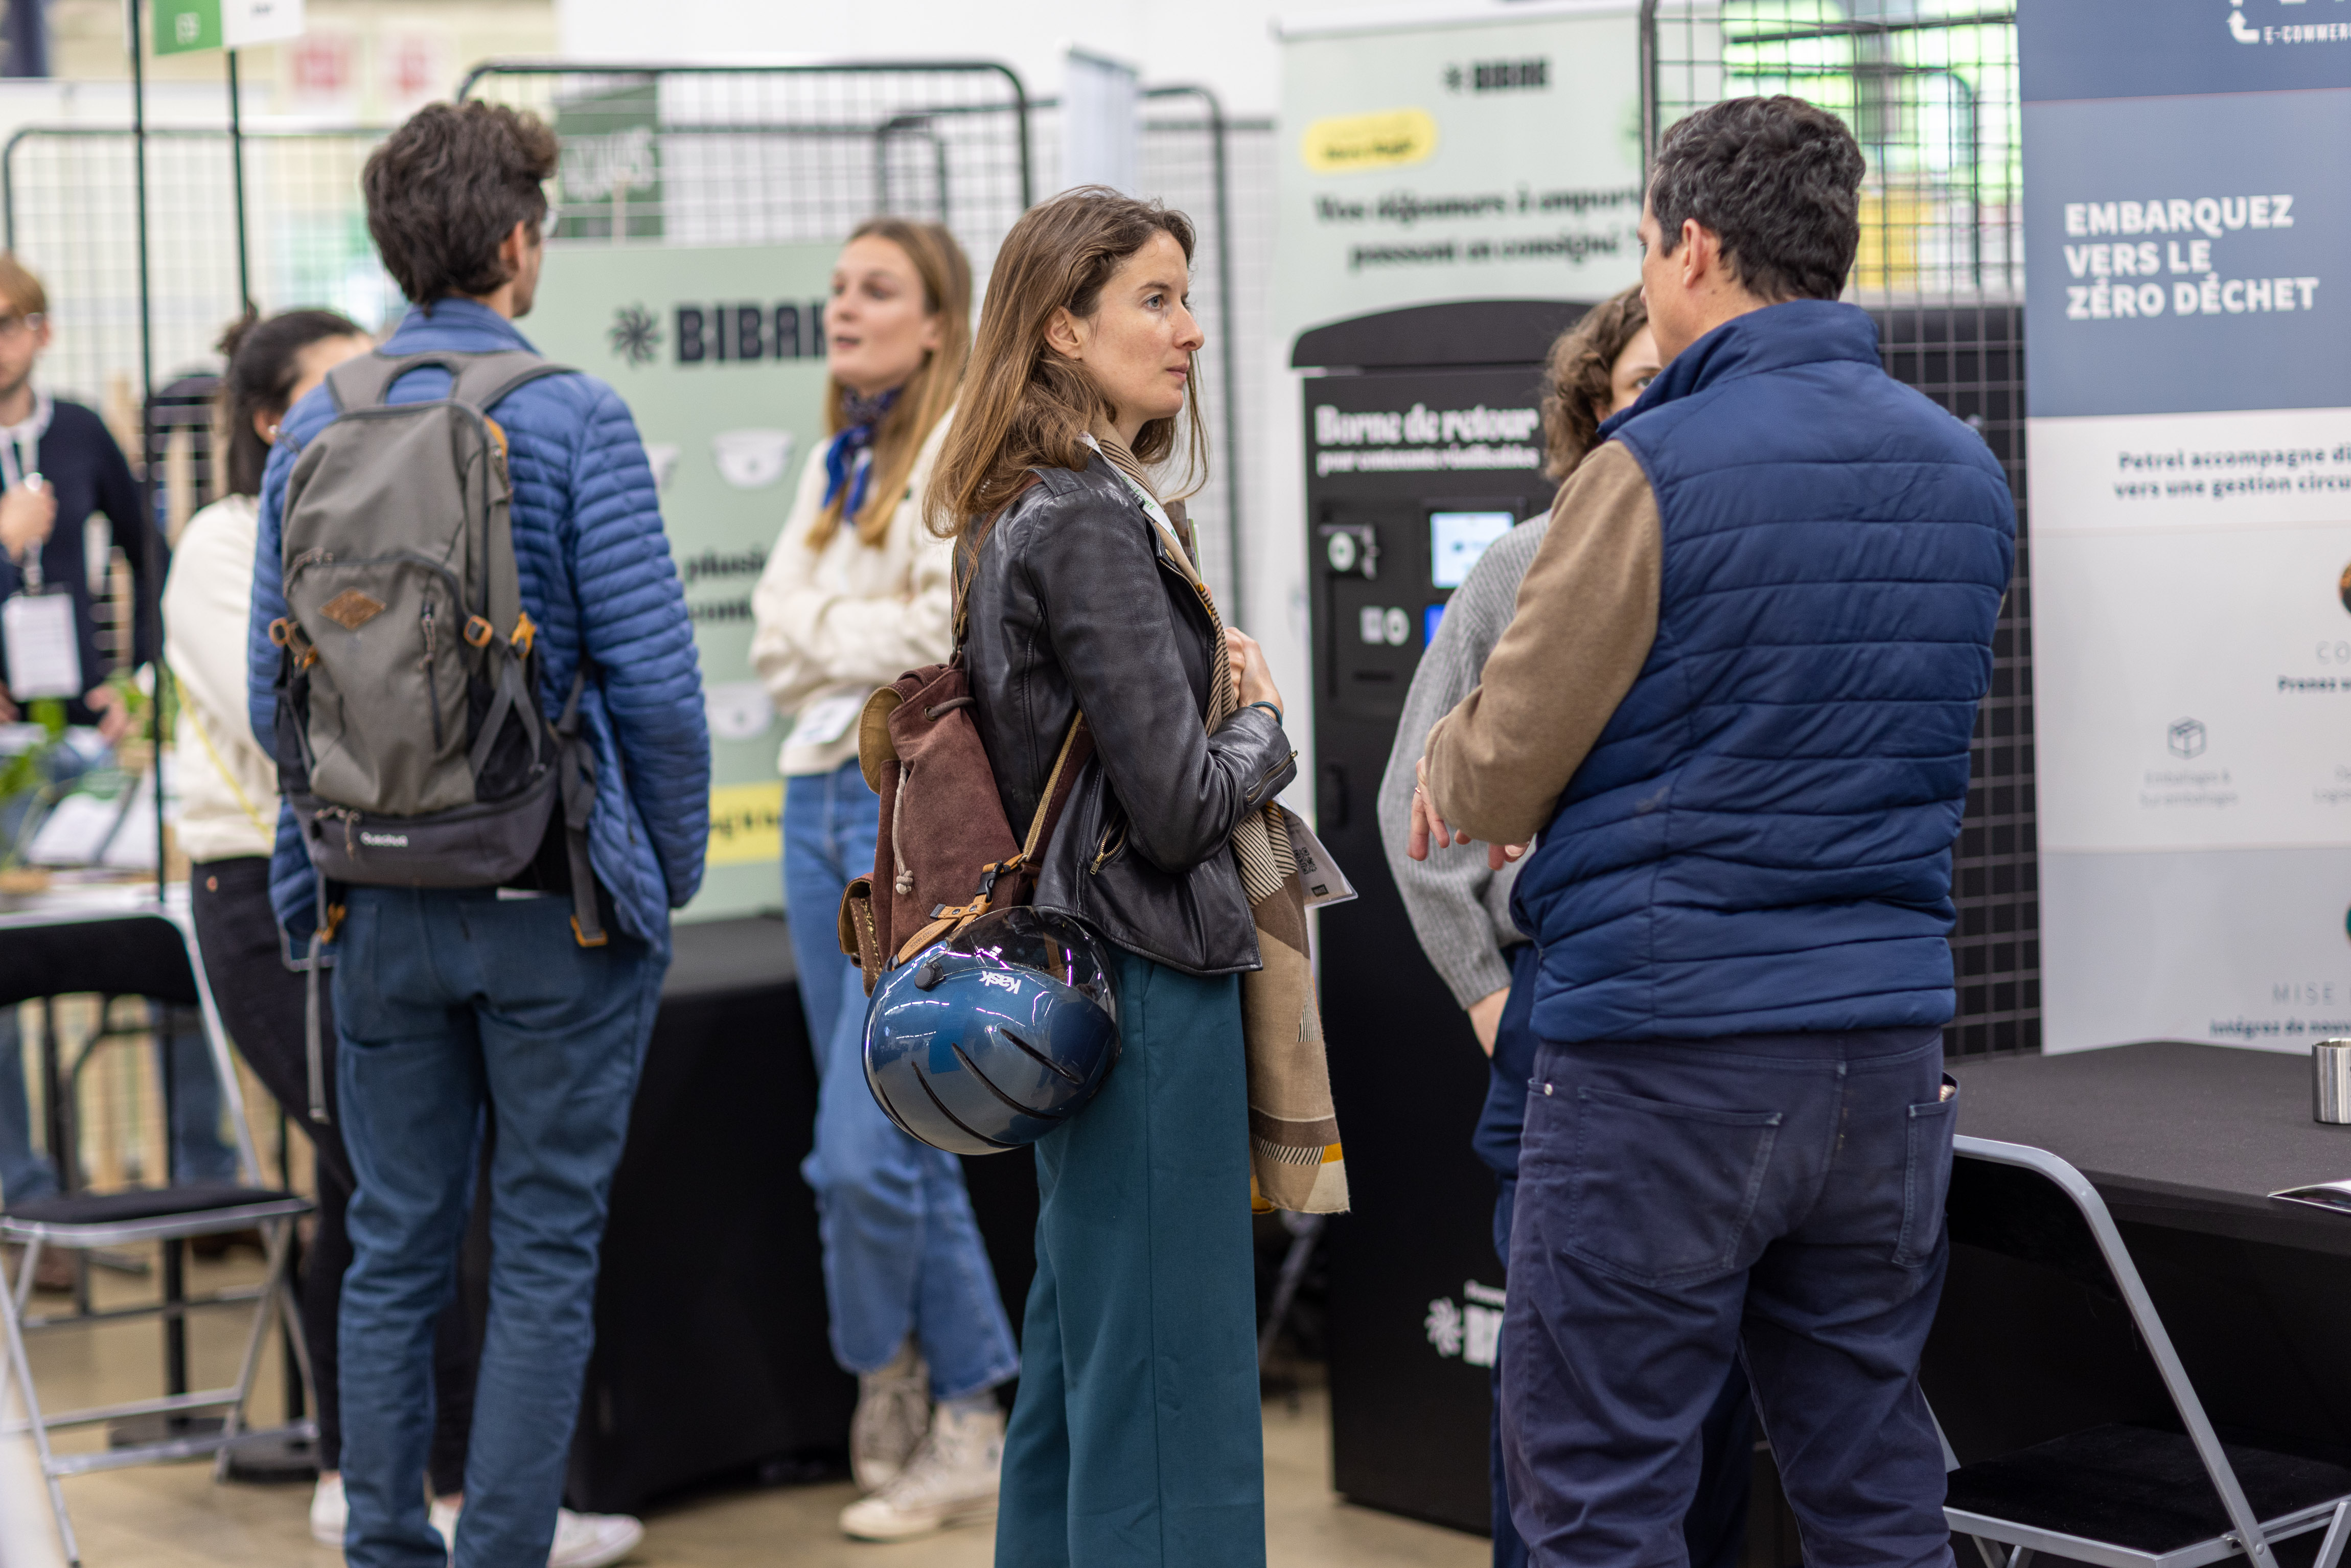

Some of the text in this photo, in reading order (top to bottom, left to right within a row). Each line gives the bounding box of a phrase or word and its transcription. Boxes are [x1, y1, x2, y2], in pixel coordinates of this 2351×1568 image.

[2065, 195, 2294, 238] EMBARQUEZ
[2063, 239, 2211, 278] VERS LE
[2066, 271, 2319, 319] ZÉRO DÉCHET
[1315, 403, 1539, 445] Borne de retour
[2119, 449, 2184, 471] Petrel
[2192, 448, 2325, 470] accompagne
[2114, 482, 2159, 499] vers
[2166, 480, 2205, 496] une
[2212, 473, 2291, 501] gestion
[978, 971, 1021, 995] Kask
[2274, 982, 2334, 1006] MISE
